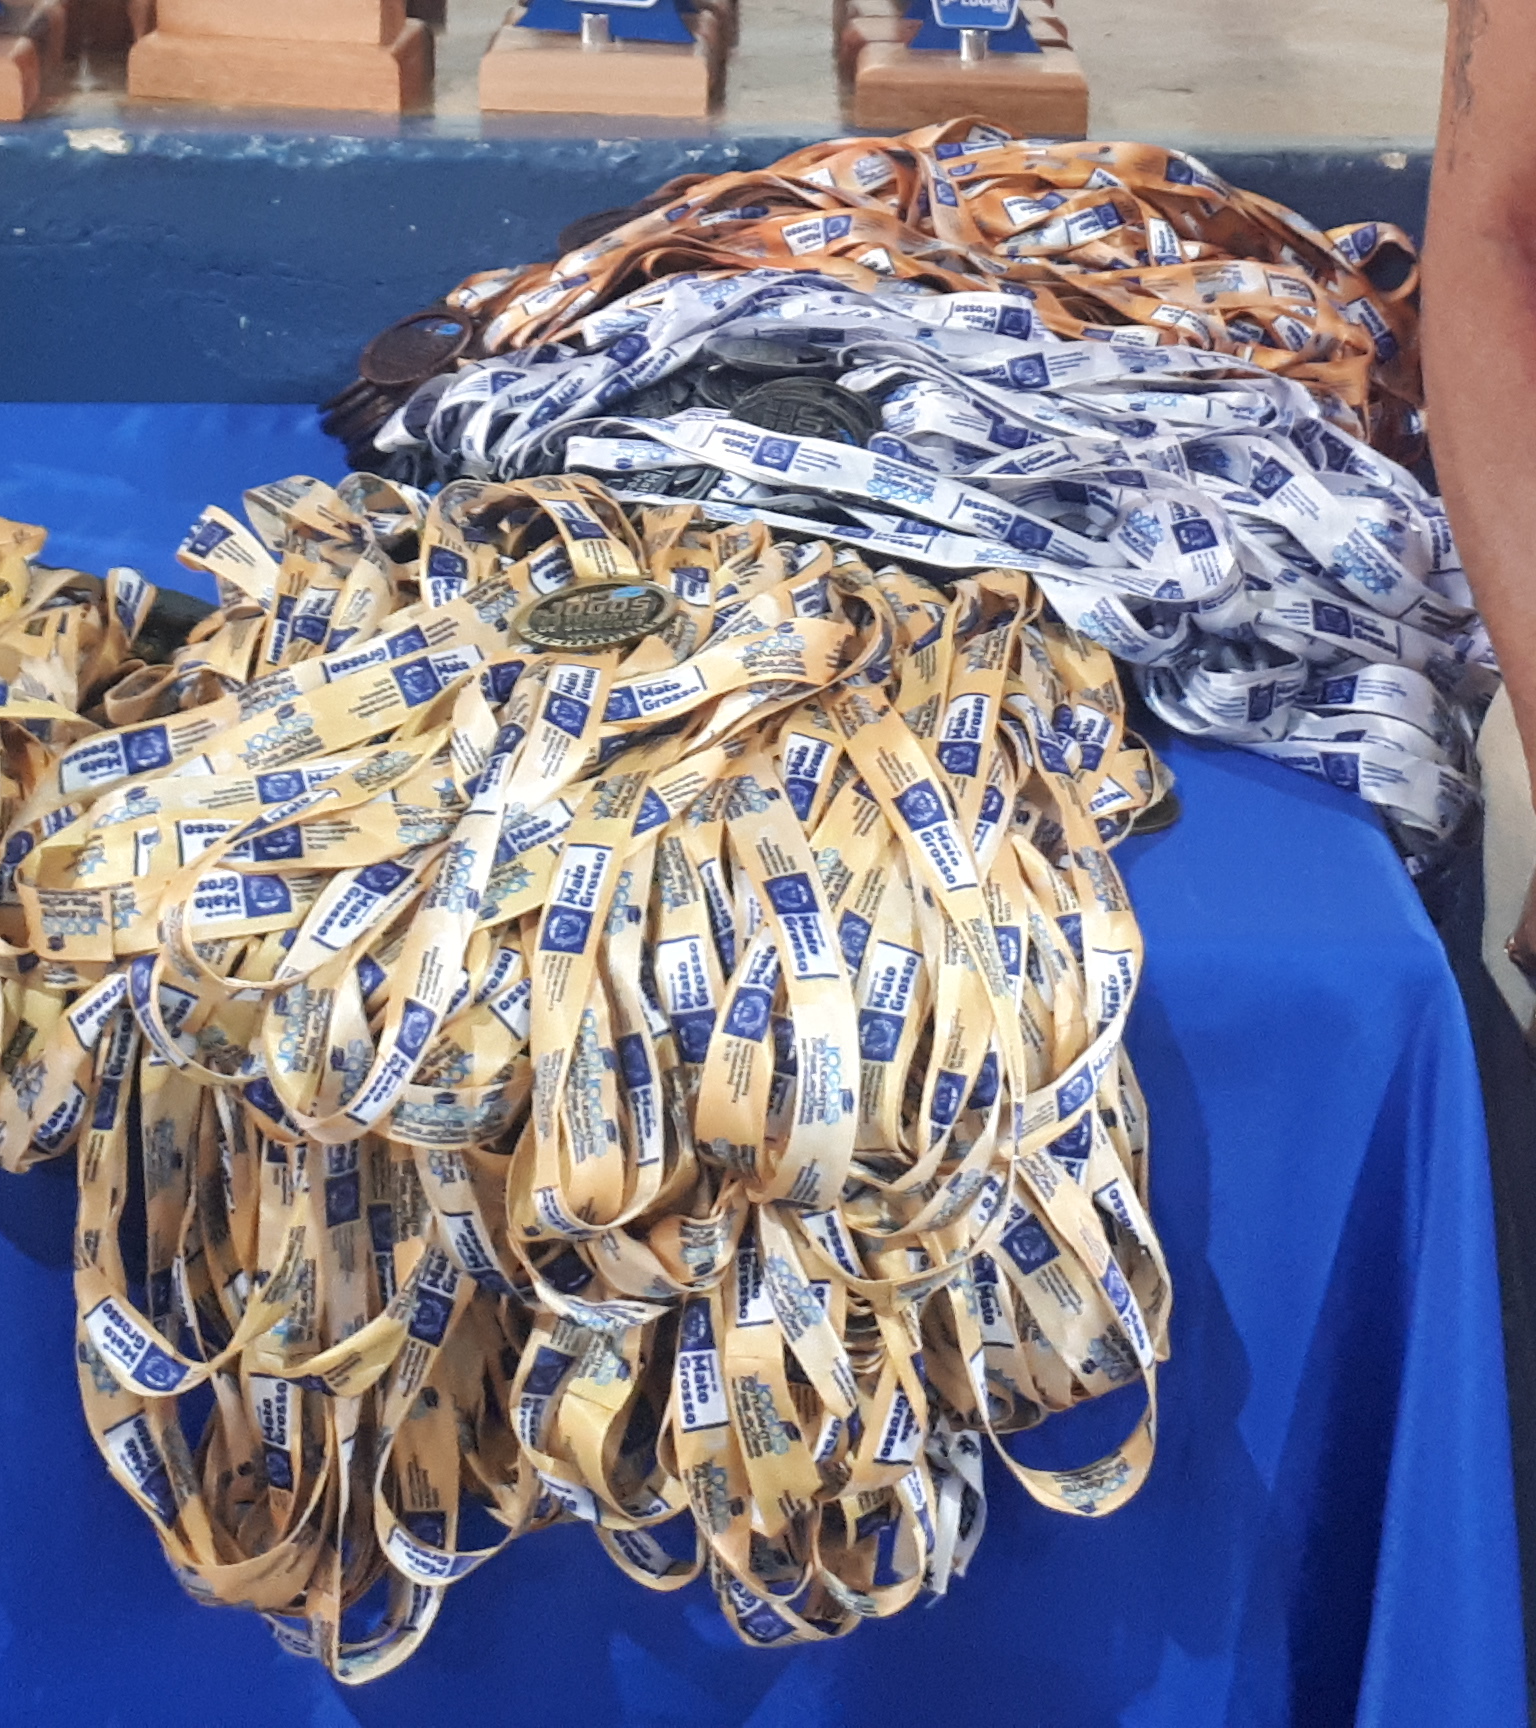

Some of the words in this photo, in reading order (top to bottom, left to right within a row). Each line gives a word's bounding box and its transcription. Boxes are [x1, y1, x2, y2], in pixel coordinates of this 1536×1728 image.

[329, 646, 387, 674] Grosso
[636, 680, 682, 699] Mato
[641, 685, 701, 711] Grosso
[508, 819, 553, 845] Mato
[932, 825, 960, 867] Mato
[578, 851, 607, 909] Grosso
[920, 831, 957, 885] Grosso
[194, 892, 241, 911] Mato
[197, 875, 239, 892] Gros
[565, 864, 586, 904] Mato
[317, 885, 362, 938] Grosso
[783, 916, 809, 973] Grosso
[677, 960, 695, 1010] Mato
[689, 941, 711, 1008] Grosso
[872, 965, 897, 1009] Mato
[888, 955, 918, 1013] Grosso
[1102, 974, 1121, 1020] Mato
[101, 1302, 147, 1351] Grosso
[678, 1355, 696, 1425] Grosso
[691, 1354, 711, 1404] Mato
